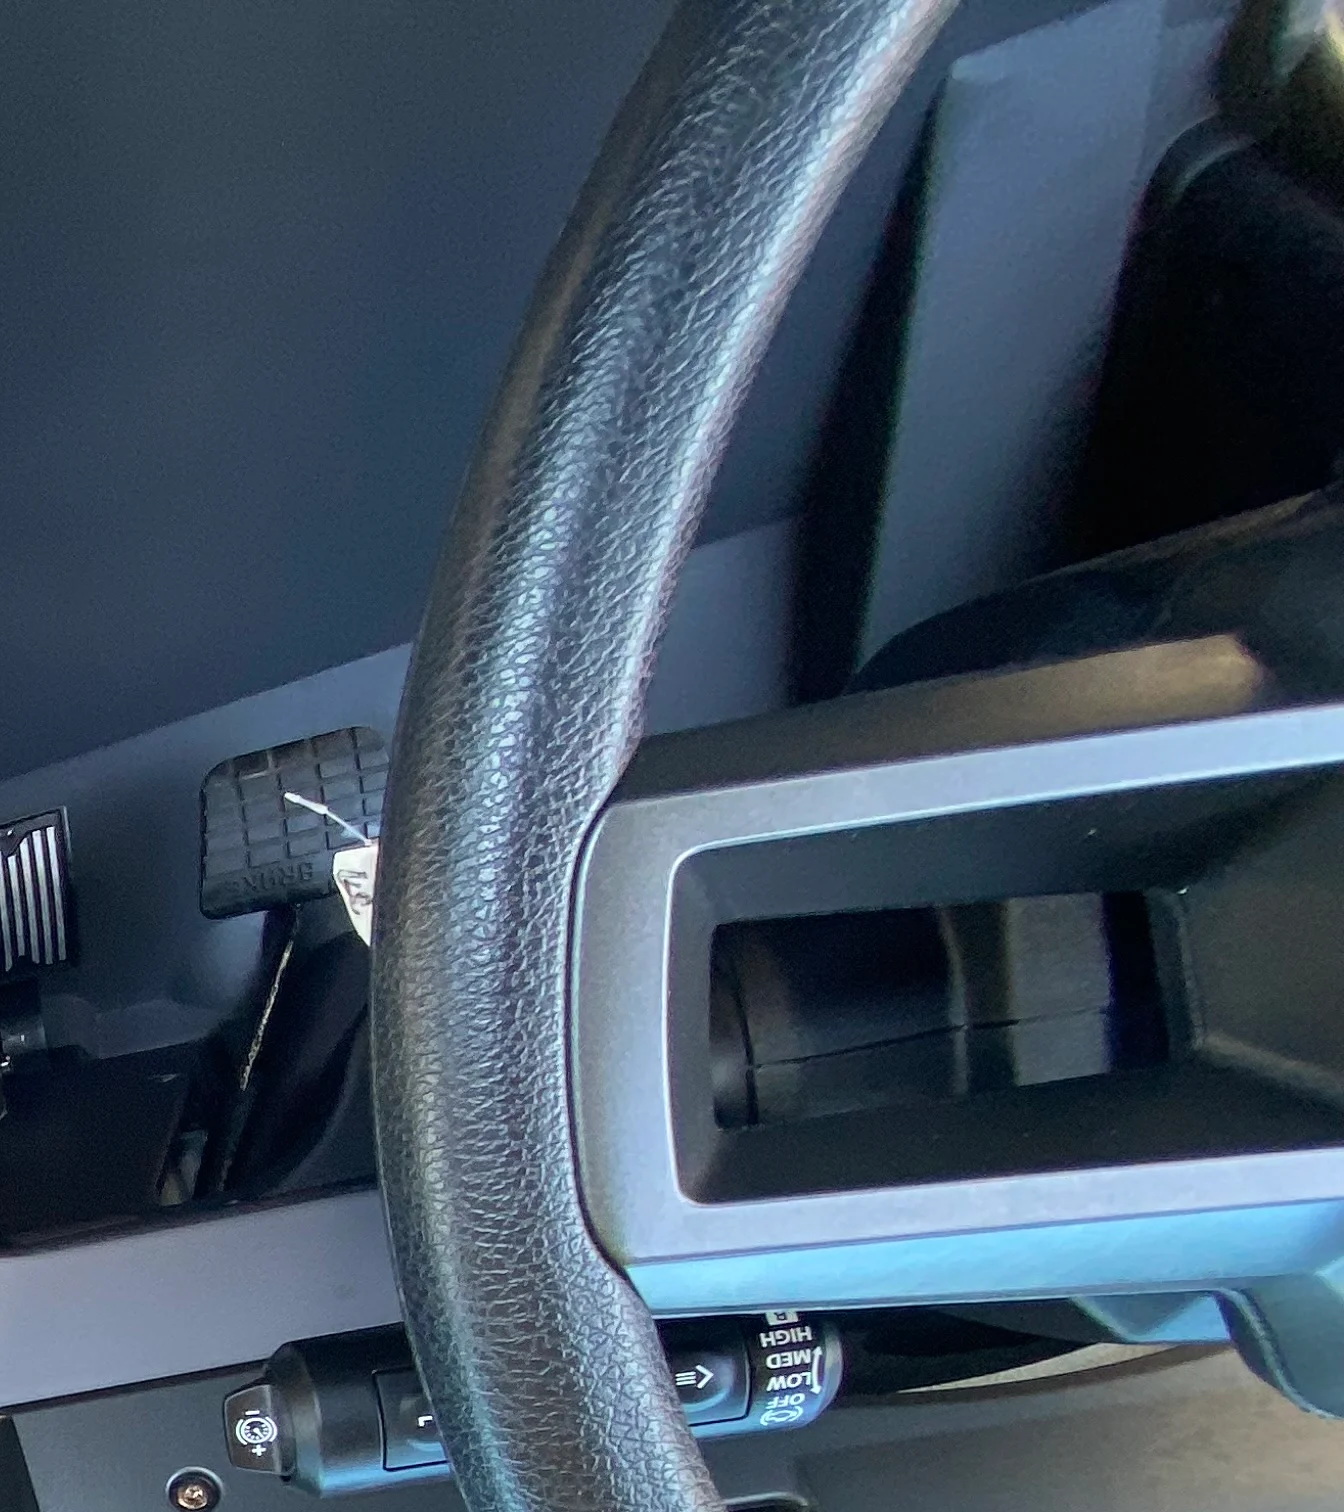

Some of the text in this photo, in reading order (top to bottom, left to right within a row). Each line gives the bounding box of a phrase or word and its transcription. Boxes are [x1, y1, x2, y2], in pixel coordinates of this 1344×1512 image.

[759, 1326, 813, 1348] HIGH
[766, 1348, 811, 1369] MED
[766, 1371, 811, 1392] LOW
[765, 1393, 805, 1409] OFF
